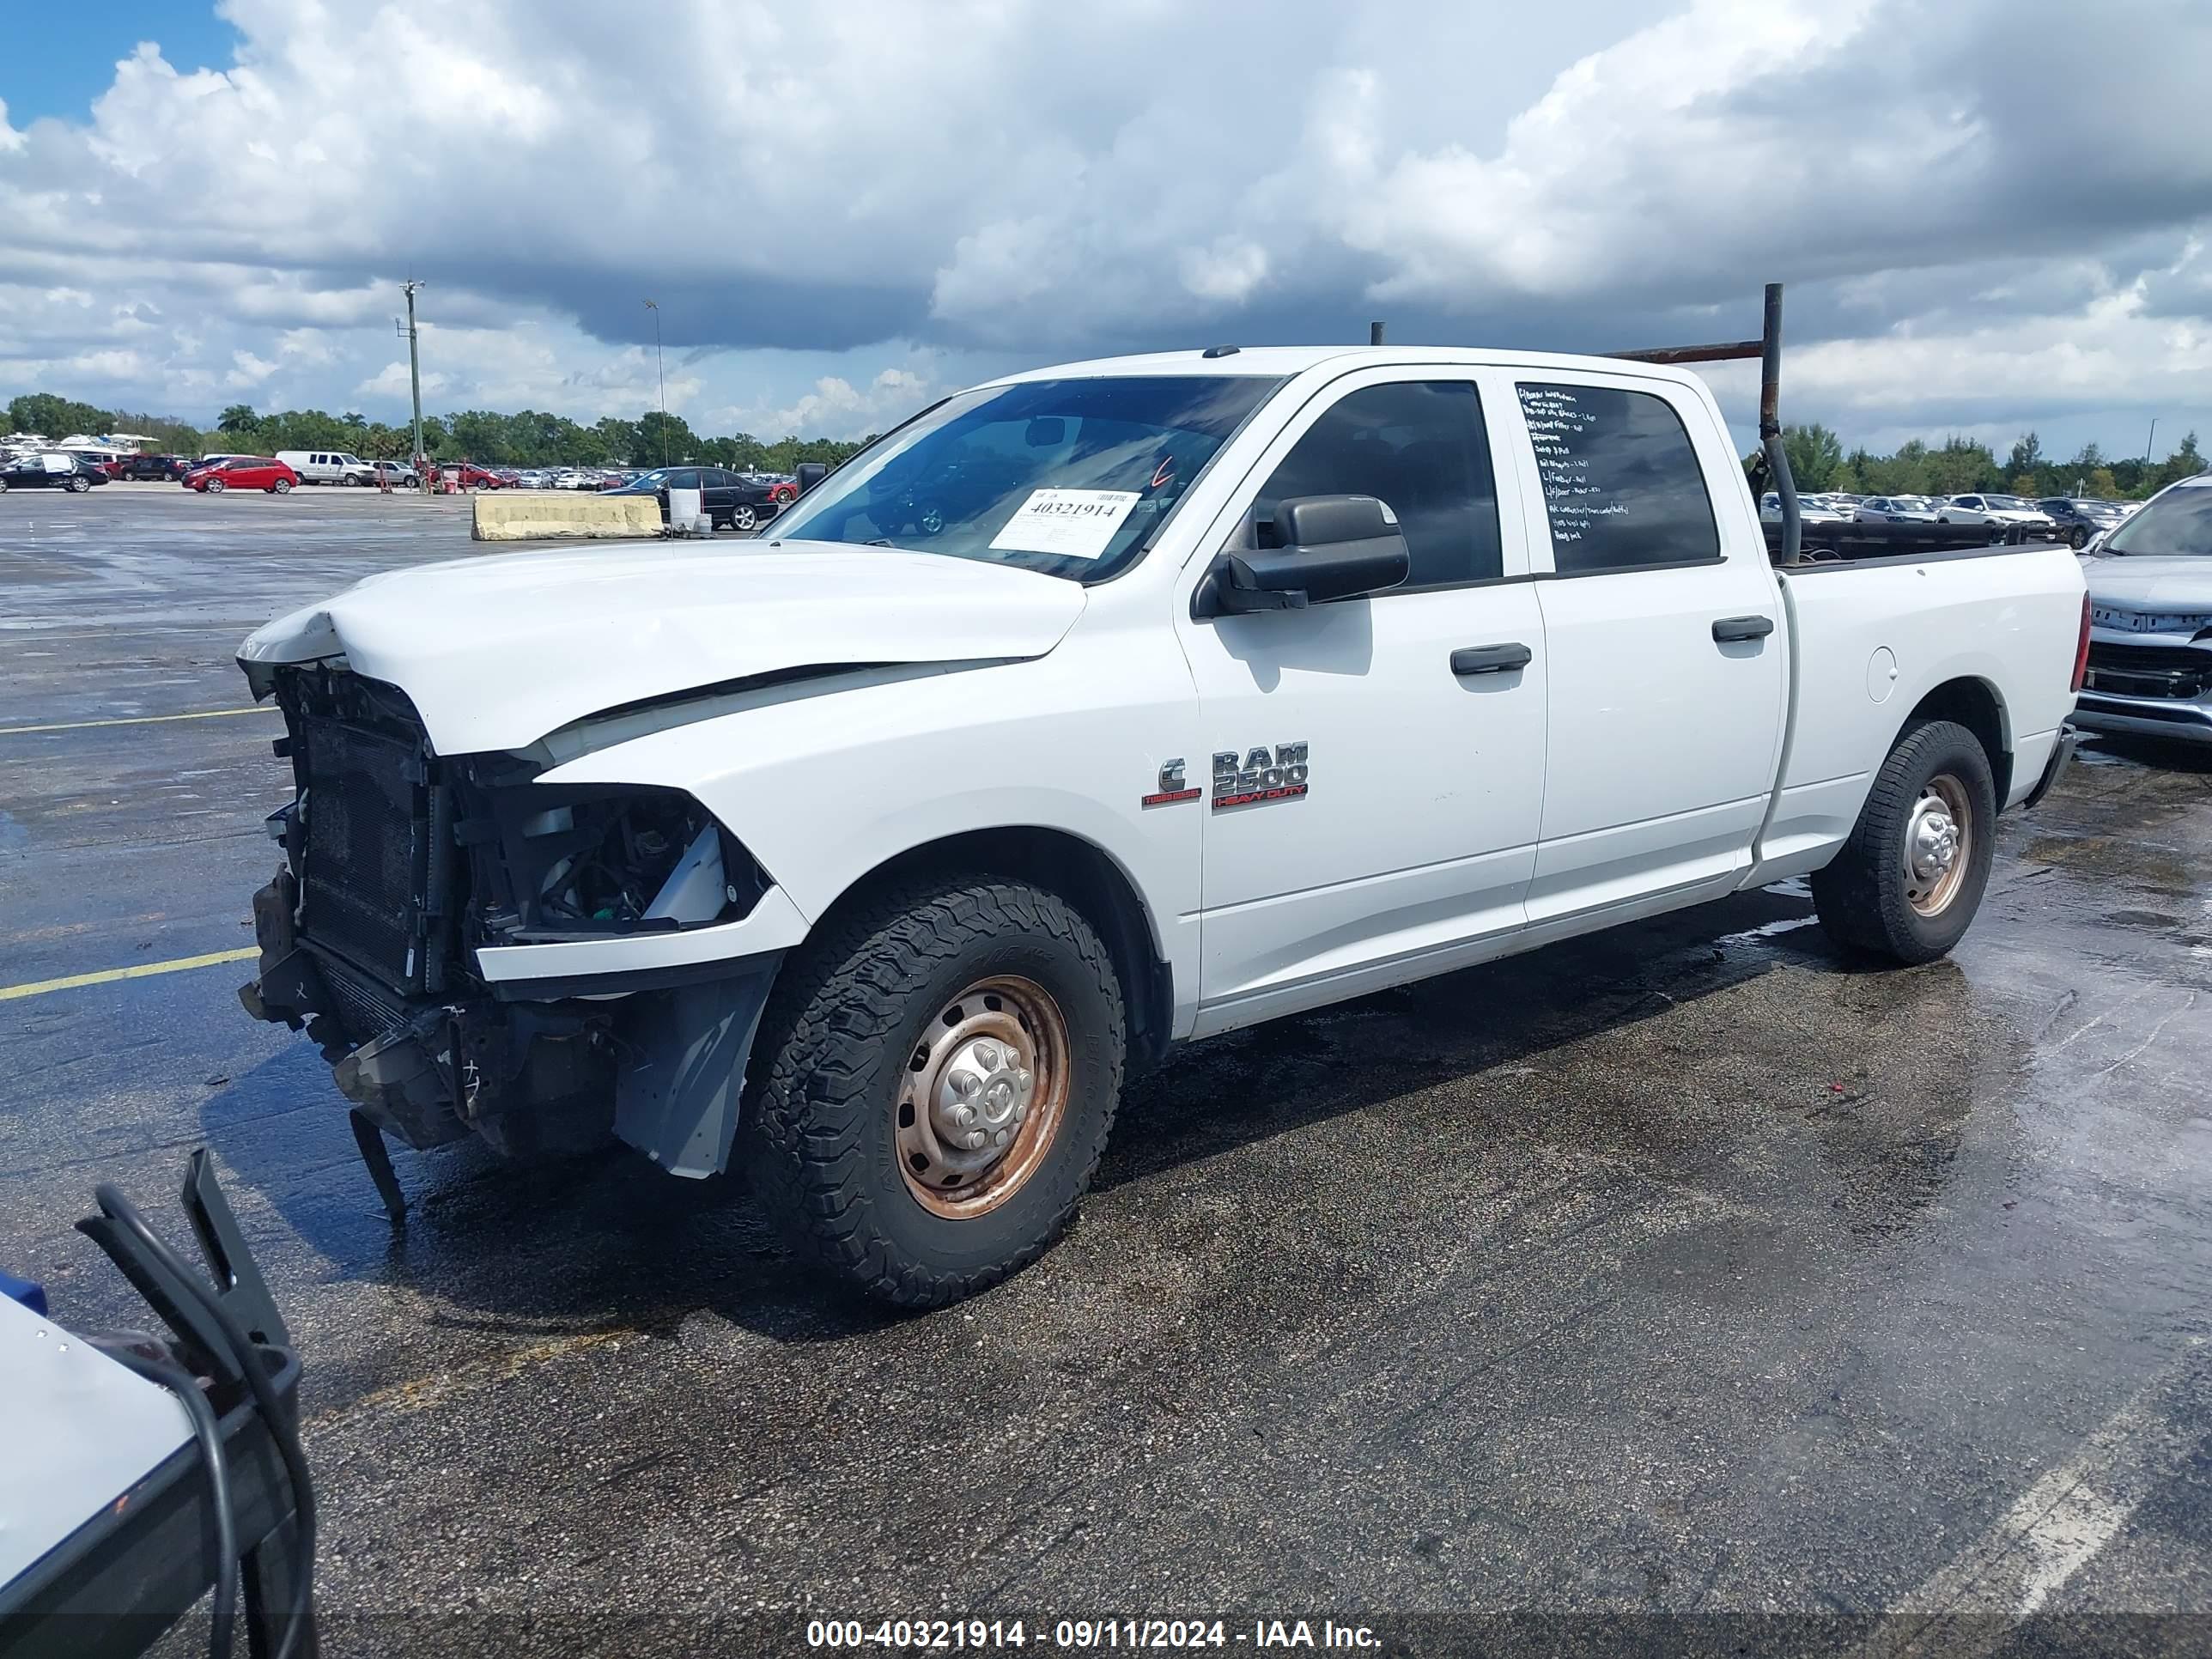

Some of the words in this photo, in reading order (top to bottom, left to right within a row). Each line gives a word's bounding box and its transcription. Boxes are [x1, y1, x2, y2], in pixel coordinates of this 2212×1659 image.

[1030, 501, 1117, 518] 40321914
[1212, 740, 1309, 774] RAM
[1212, 762, 1309, 797] 2500
[1145, 793, 1173, 805] TURBO
[1173, 788, 1200, 800] DIESEL
[1218, 792, 1264, 806] HEAVY
[1267, 785, 1306, 799] DUTY
